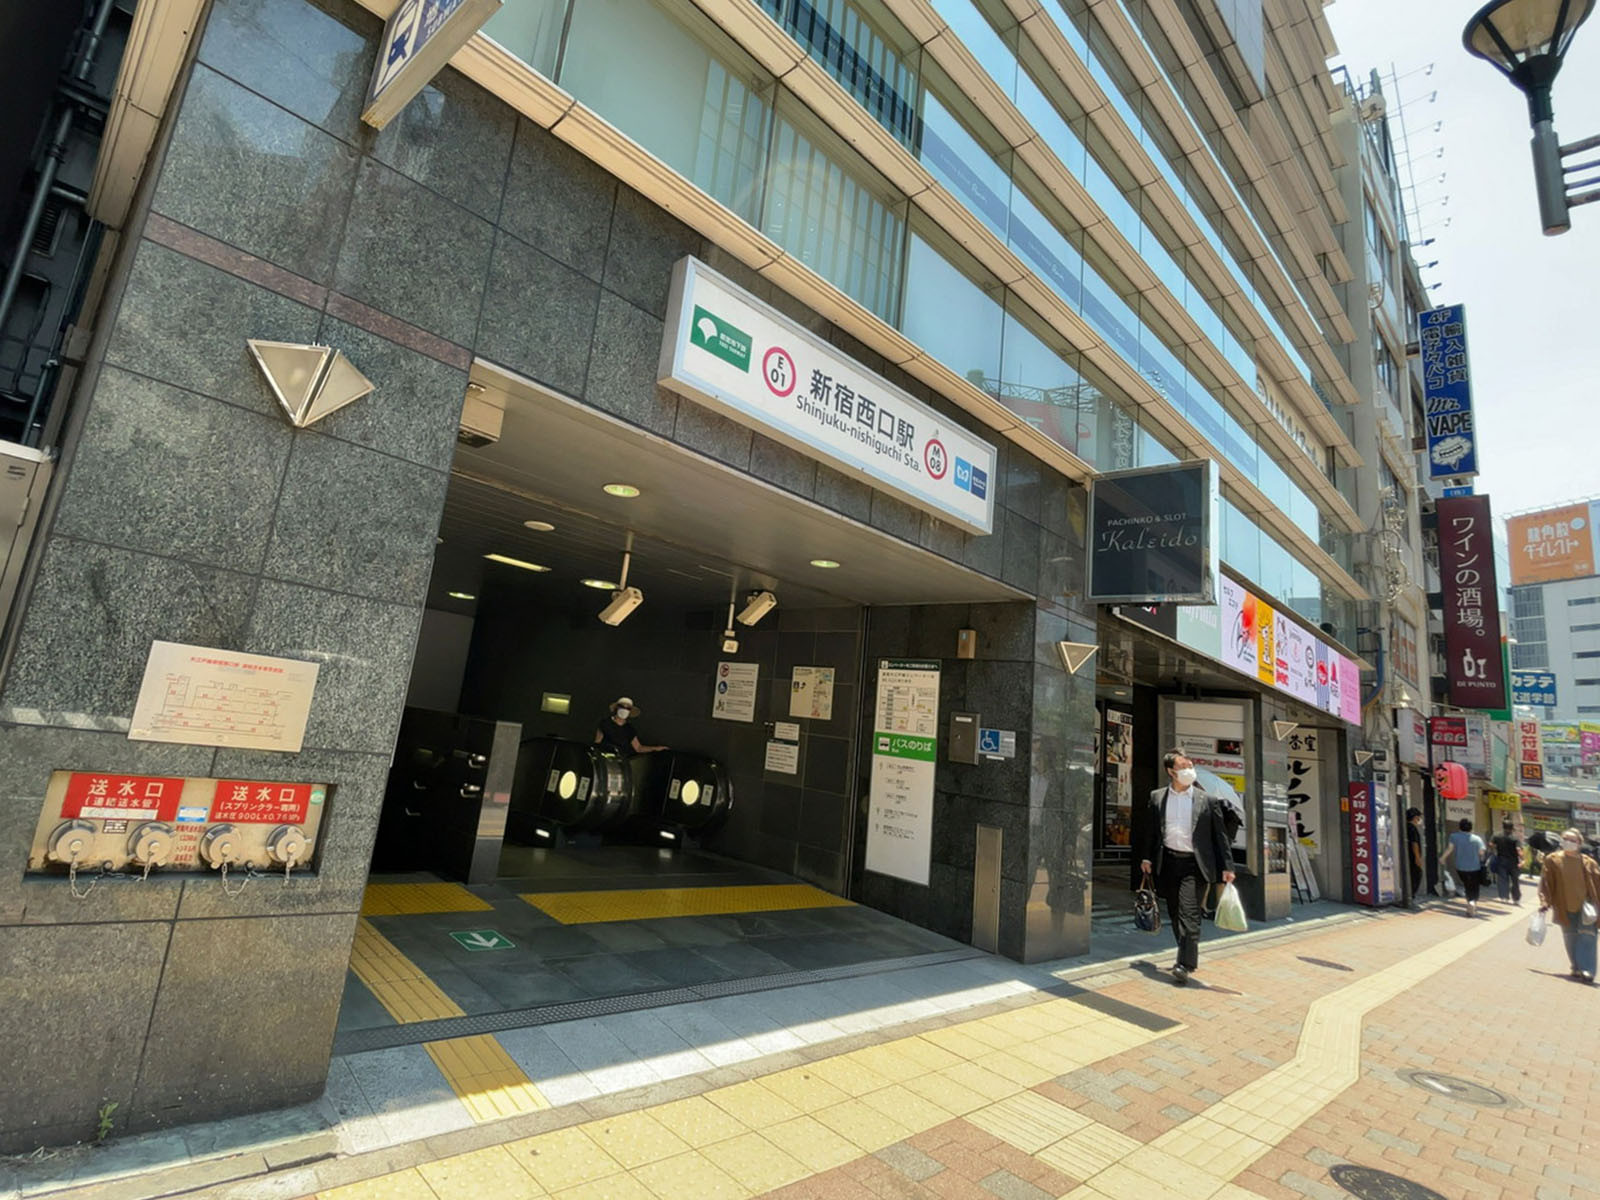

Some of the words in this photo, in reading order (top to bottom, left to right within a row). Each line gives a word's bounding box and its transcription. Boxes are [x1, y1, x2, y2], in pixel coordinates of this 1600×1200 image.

[1428, 311, 1451, 323] 4F
[778, 356, 785, 369] E
[1422, 325, 1444, 390] 電子タバコ
[1442, 322, 1465, 384] 輸入雑貨
[771, 368, 786, 387] 01
[810, 368, 915, 451] 新宿西口駅
[796, 395, 902, 463] Shinjuku-nishiguchi
[904, 453, 921, 472] Sta.
[1427, 411, 1472, 437] VAPE
[932, 446, 940, 458] M
[930, 457, 941, 472] 08
[1107, 516, 1152, 526] PACHINKO
[1163, 512, 1187, 521] SLOT
[1098, 525, 1197, 552] Kaleido
[1452, 517, 1485, 636] ワインの酒場。
[892, 737, 933, 752] バスのりば
[1288, 734, 1316, 752] 茶室
[88, 778, 164, 798] 送水口
[231, 785, 296, 802] 送水口
